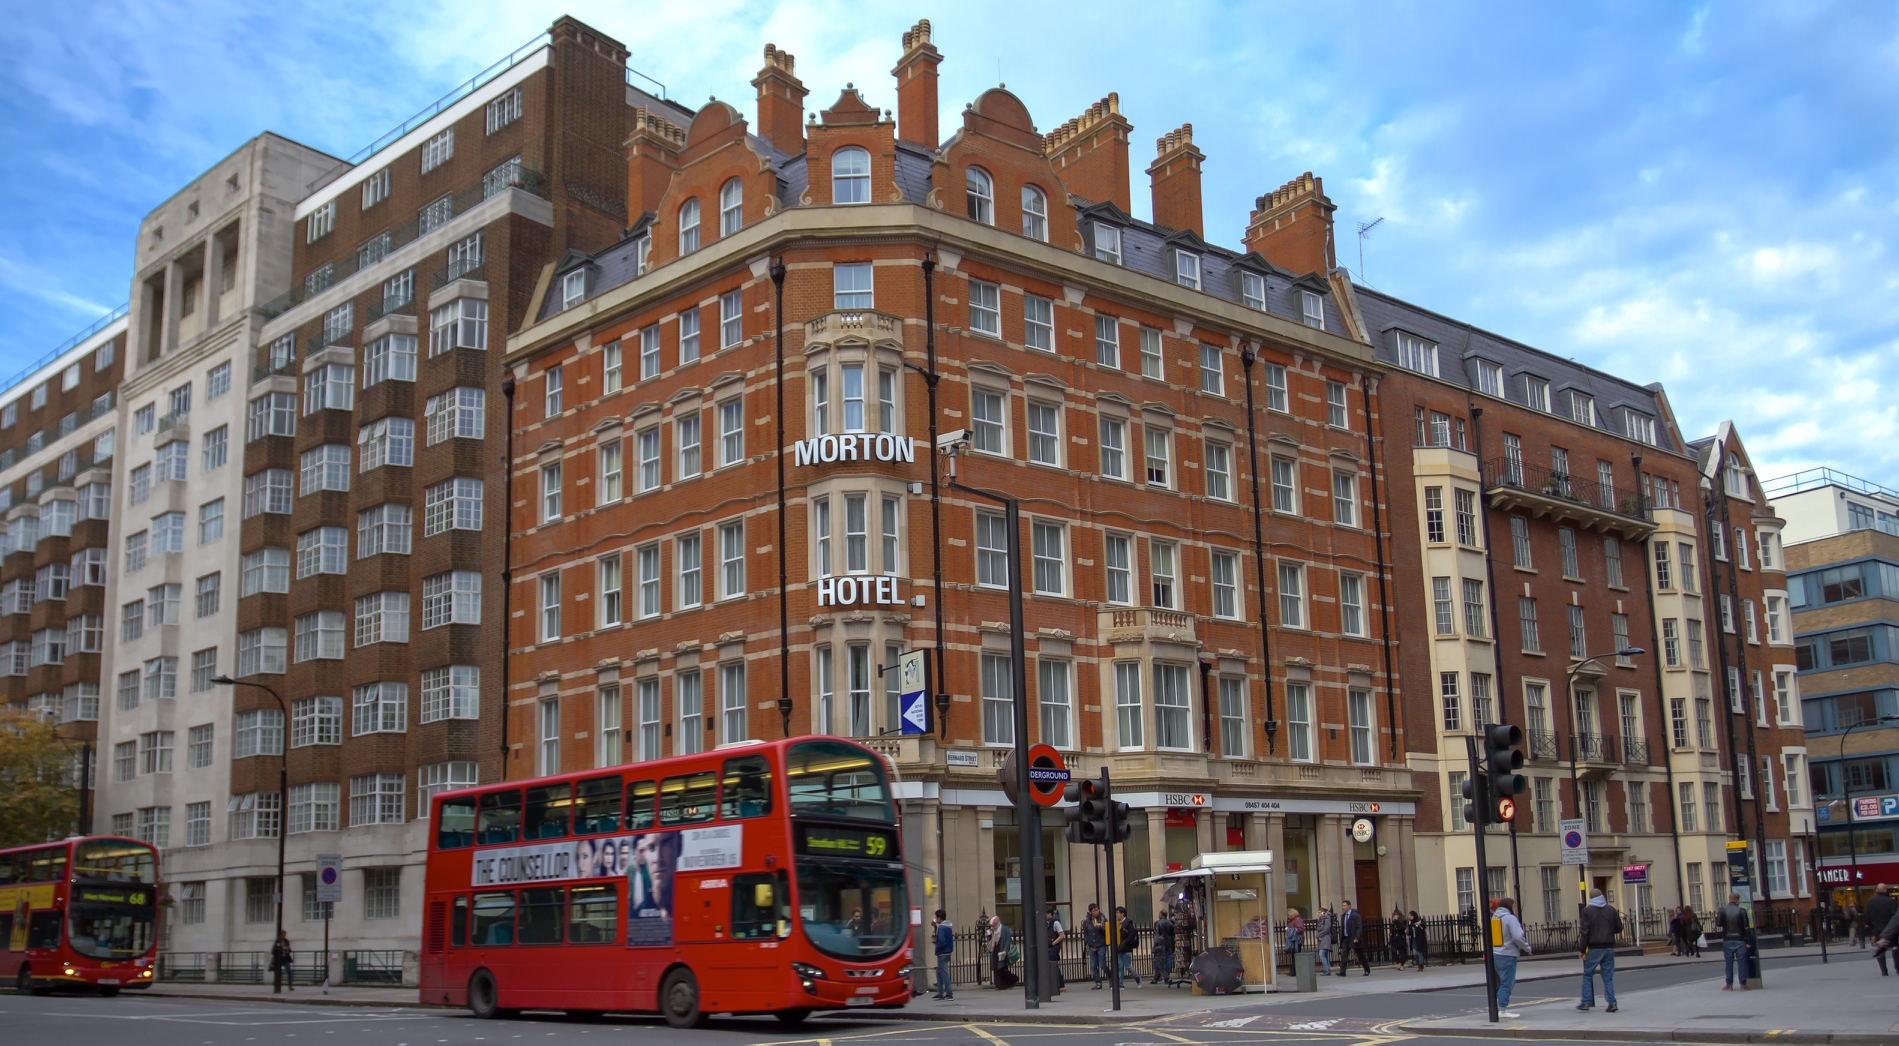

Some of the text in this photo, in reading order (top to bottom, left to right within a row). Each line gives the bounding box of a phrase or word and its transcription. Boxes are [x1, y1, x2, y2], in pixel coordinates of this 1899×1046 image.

[795, 434, 915, 467] MORTON
[818, 577, 906, 606] HOTEL
[1030, 771, 1068, 780] DERGROUND
[1165, 794, 1190, 805] HSBC
[1349, 802, 1369, 812] HSBC
[1884, 798, 1897, 814] P
[866, 836, 886, 855] 59
[476, 852, 569, 884] THE COUNSELLOR
[129, 892, 146, 905] 68
